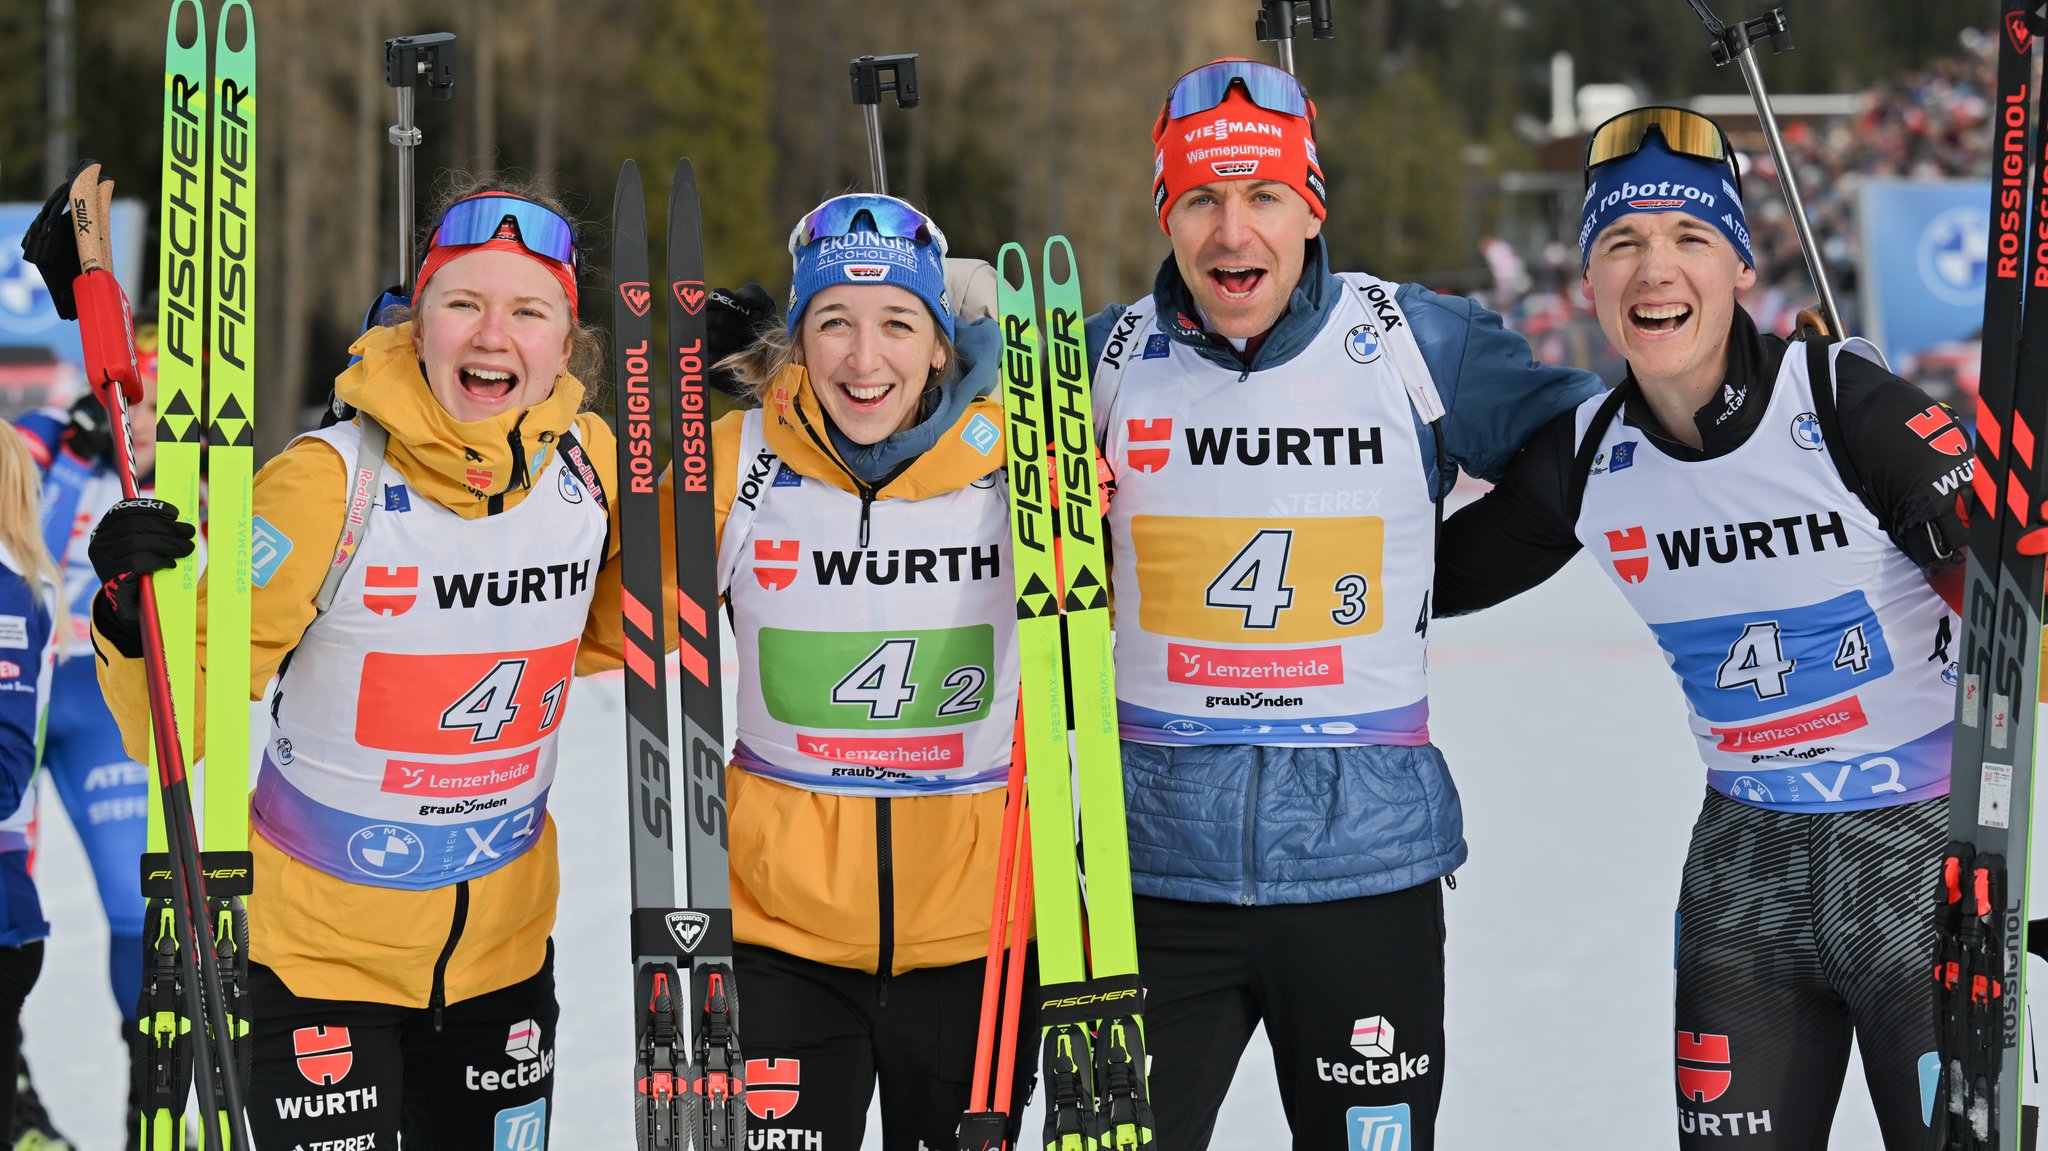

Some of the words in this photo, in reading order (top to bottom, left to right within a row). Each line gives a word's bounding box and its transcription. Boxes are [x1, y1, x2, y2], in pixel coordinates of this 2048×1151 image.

[1187, 144, 1281, 164] Wärmepumpen
[1600, 181, 1715, 212] robotron
[1997, 84, 2026, 278] ROSSIGNOL
[167, 73, 199, 367] FISCHER
[218, 78, 249, 370] FISCHER
[818, 230, 918, 259] ERDINGER
[818, 250, 918, 269] ALKOHOLFREI
[1359, 282, 1399, 333] JOKA
[1102, 313, 1143, 370] JOKA
[626, 340, 654, 494] ROSSIGNOL
[680, 338, 708, 492] ROSSIGNOL
[1005, 313, 1046, 552] FISCHER
[1052, 306, 1095, 546] FISCHER
[1185, 427, 1384, 466] WÜRTH
[738, 451, 778, 511] JOKA
[812, 544, 1000, 586] WÜRTH
[1656, 510, 1850, 571] WÜRTH
[432, 558, 590, 610] WÜRTH
[1204, 528, 1295, 630] 4
[1331, 572, 1368, 626] 3
[830, 638, 919, 720] 4
[936, 665, 988, 718] 2
[1208, 660, 1329, 678] Lenzerheide
[1715, 620, 1796, 702] 4
[1833, 623, 1872, 675] 4
[438, 658, 528, 744] 4
[539, 678, 566, 731] 1
[1049, 678, 1062, 742] SPEEDMAX
[1100, 672, 1112, 734] SPEEDMAX
[429, 762, 530, 790] Lenzerheide
[1787, 775, 1800, 801] NEW
[446, 830, 458, 853] NEW
[148, 868, 248, 880] FIHER
[1041, 988, 1138, 1010] FISCHER
[466, 1048, 554, 1092] tectake
[1316, 1051, 1430, 1086] tectake
[276, 1086, 378, 1120] WÜRTH
[1678, 1109, 1772, 1136] ÜRTH
[747, 1128, 823, 1151] ÜRTH
